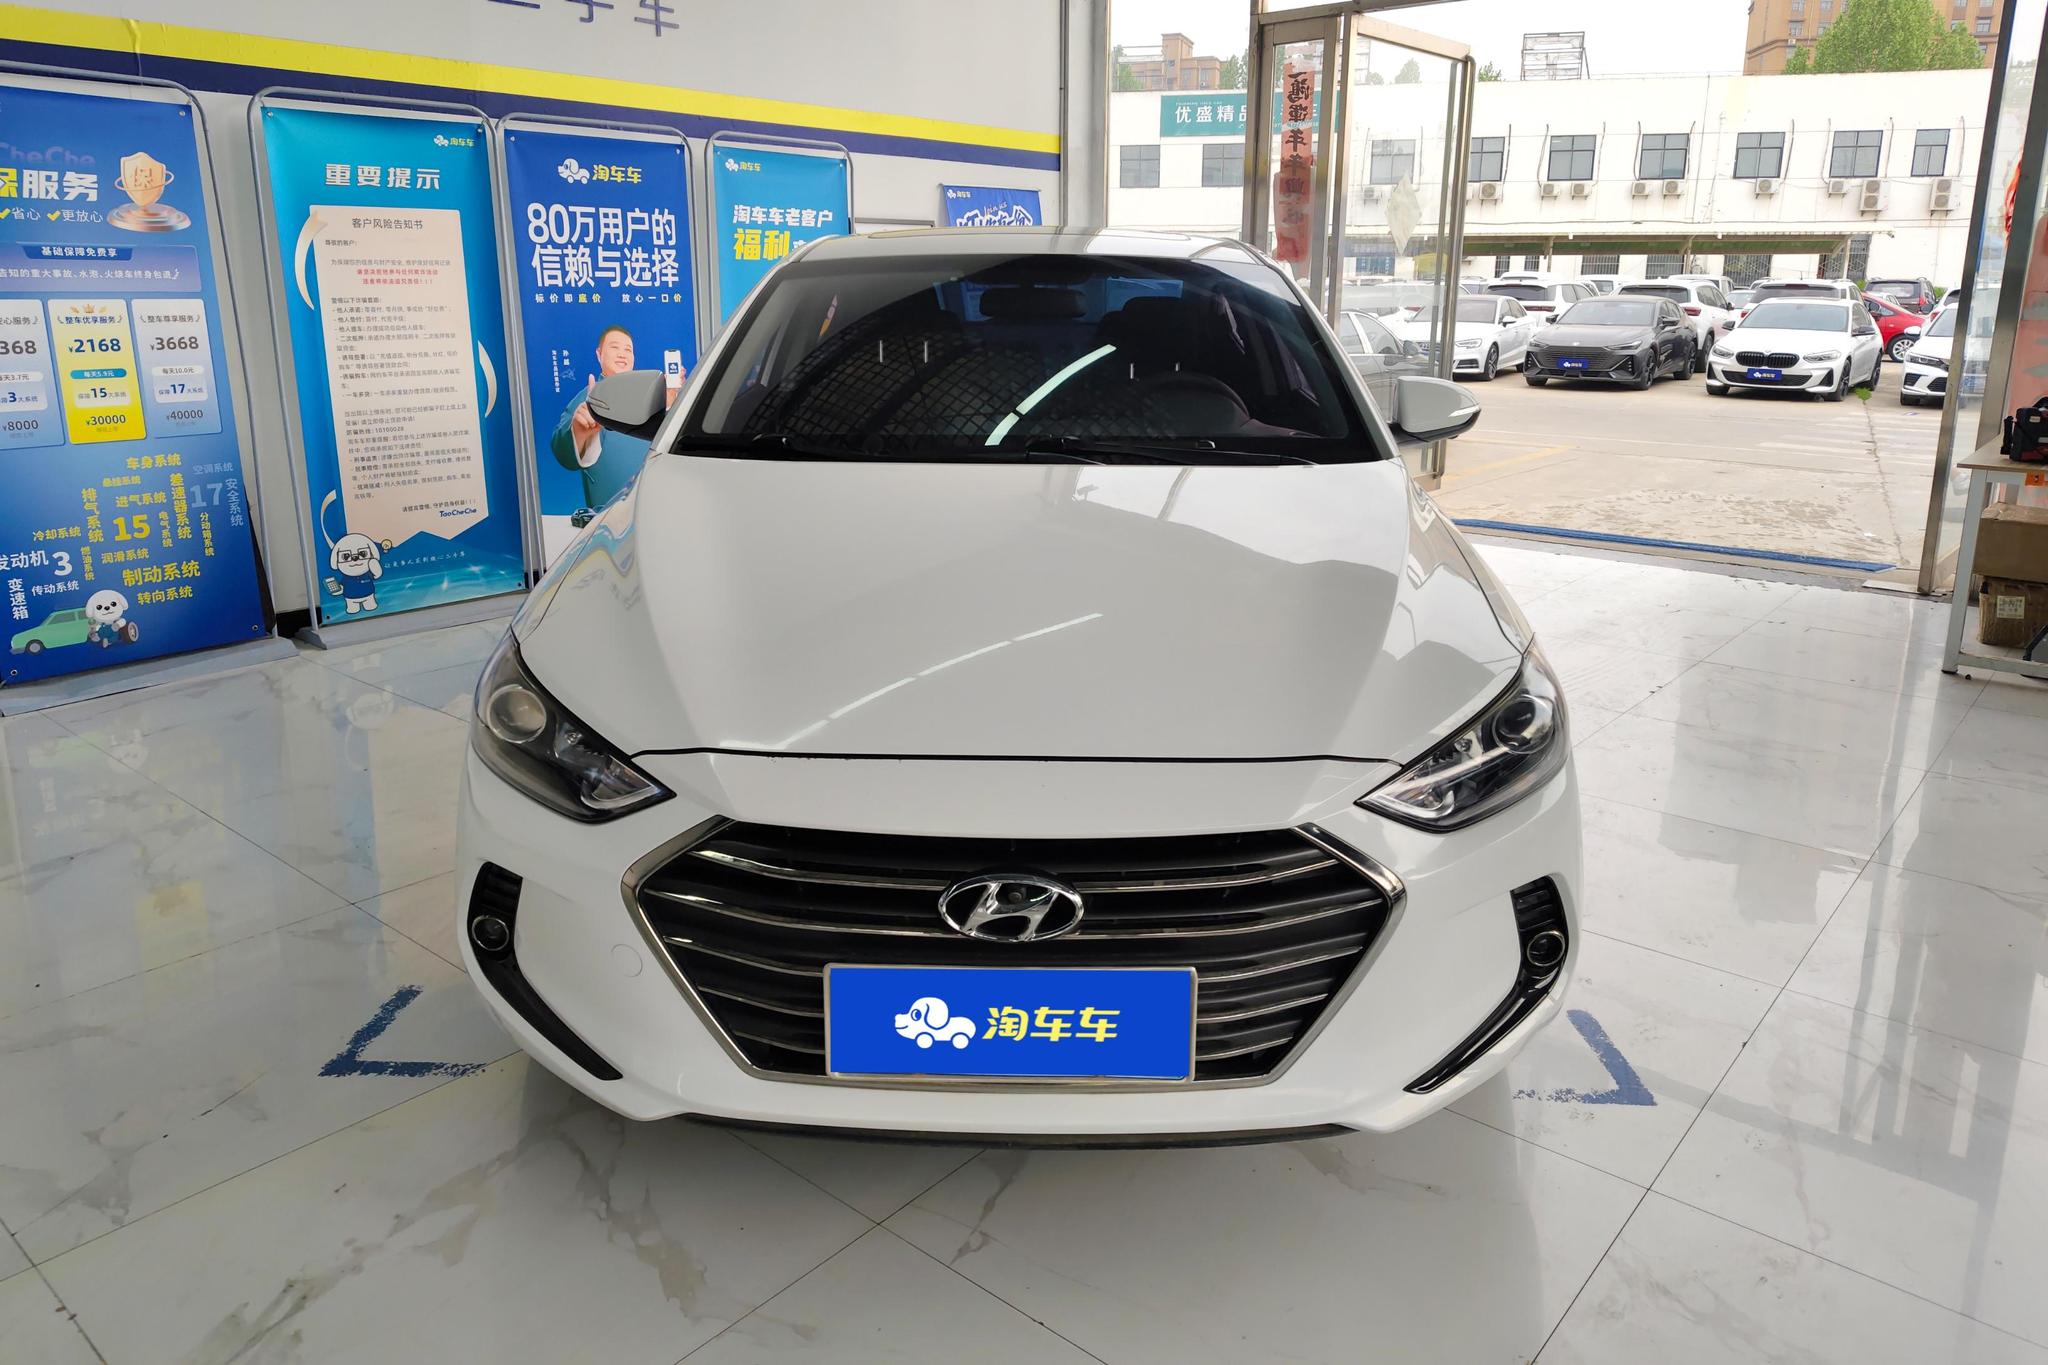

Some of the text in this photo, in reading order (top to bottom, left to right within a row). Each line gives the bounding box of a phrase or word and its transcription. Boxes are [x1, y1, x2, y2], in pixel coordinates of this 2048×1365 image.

[324, 163, 441, 190] 重要提示
[591, 163, 643, 184] 淘车车
[12, 207, 104, 224] 省心 更放心
[351, 217, 424, 230] 客户风险告知书
[527, 202, 677, 246] 80万用户的
[733, 204, 833, 228] 淘车车老客户
[41, 246, 118, 258] 基础保障免费享
[531, 244, 680, 288] 信赖与选择
[535, 293, 601, 304] 标价即底价
[622, 293, 682, 303] 放心一口价
[65, 315, 117, 324] 整车优享服务
[68, 338, 122, 354] ¥2168
[150, 336, 199, 351] ¥3668
[86, 414, 126, 427] ¥30000
[166, 410, 204, 421] ¥40000
[126, 453, 183, 470] 车身系统
[193, 462, 234, 475] 空调系统
[115, 491, 167, 508] 进气系统
[189, 482, 223, 509] 17
[225, 478, 244, 528] 安全系统
[81, 488, 104, 543] 排气系统
[169, 472, 193, 540] 差速器系统
[32, 526, 82, 542] 冷却系统
[112, 513, 151, 542] 15
[158, 511, 173, 548] 电气系统
[52, 551, 73, 576] 3
[101, 547, 150, 564] 润滑系统
[122, 559, 201, 588] 制动系统
[31, 580, 80, 597] 传动系统
[136, 584, 194, 606] 转向系统
[8, 578, 29, 621] 变速箱
[982, 1004, 1120, 1042] 淘车车
